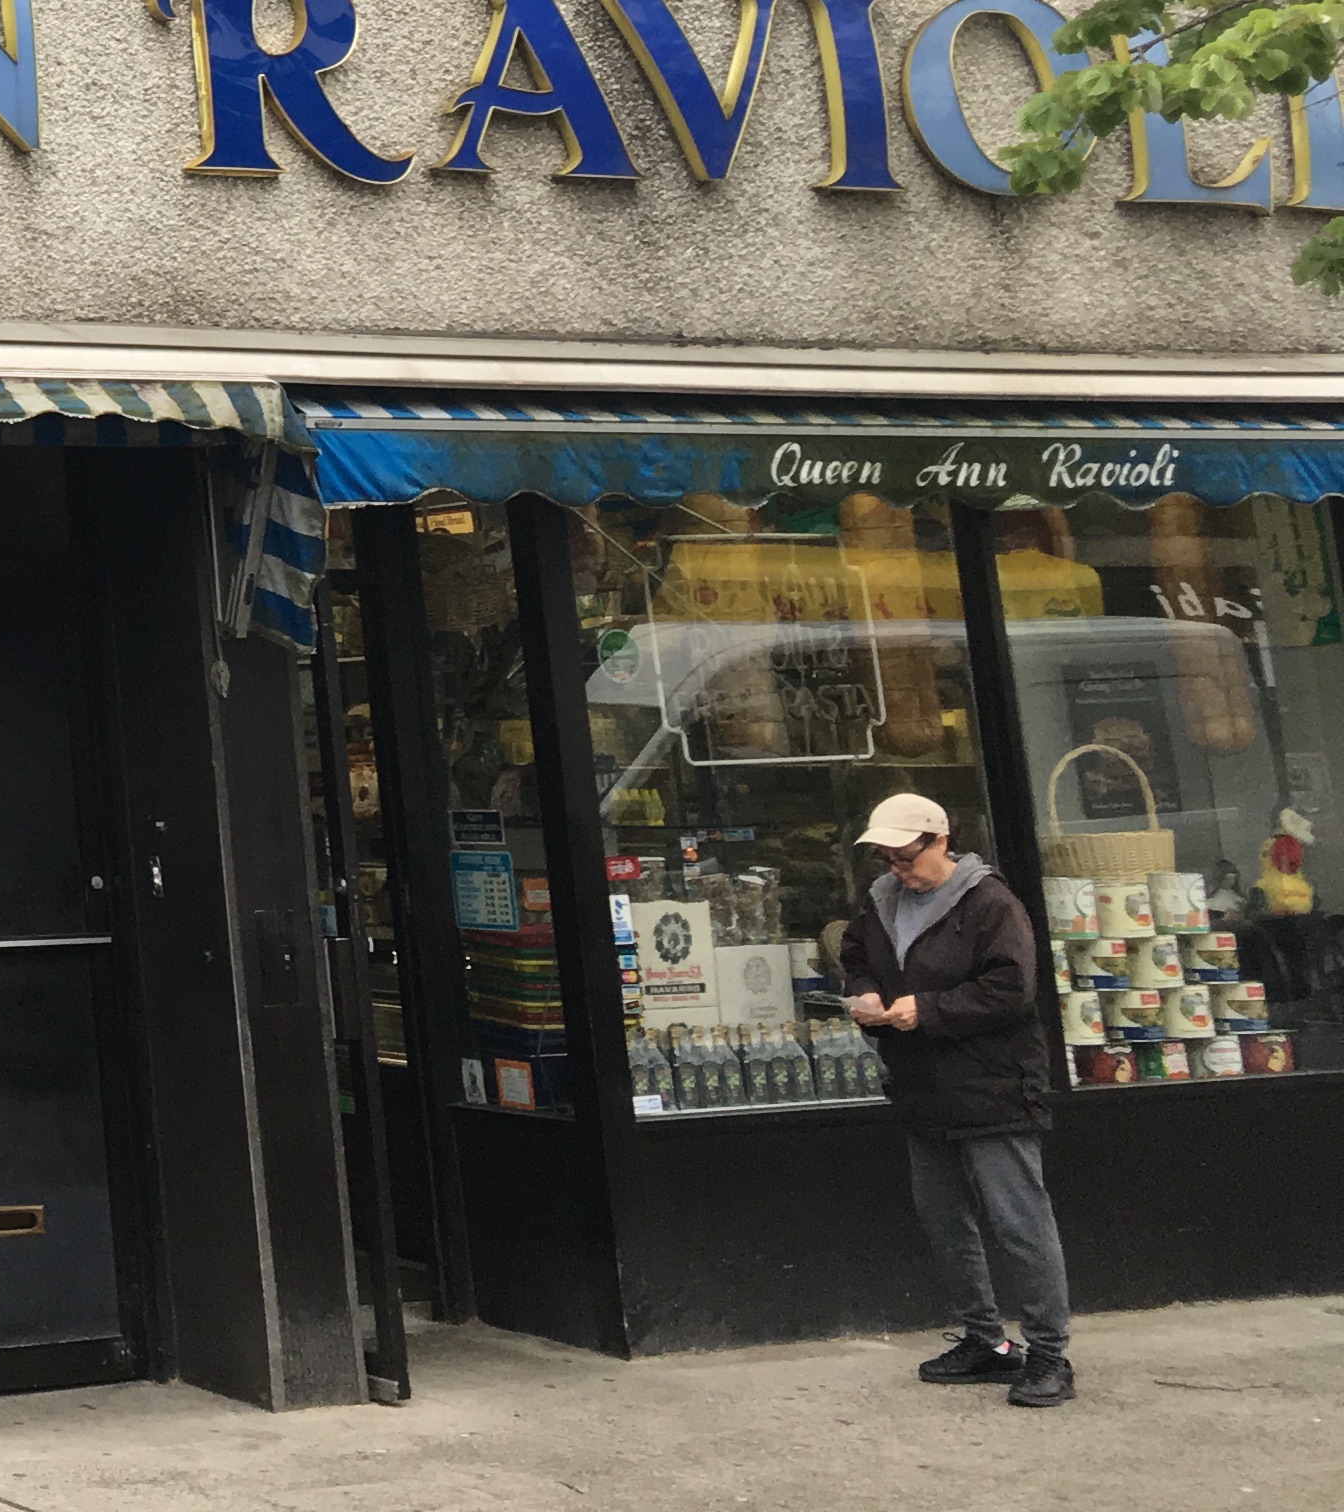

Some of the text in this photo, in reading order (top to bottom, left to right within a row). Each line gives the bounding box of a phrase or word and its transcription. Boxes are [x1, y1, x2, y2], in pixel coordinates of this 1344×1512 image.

[770, 441, 1181, 488] Queen Ann Ravioli
